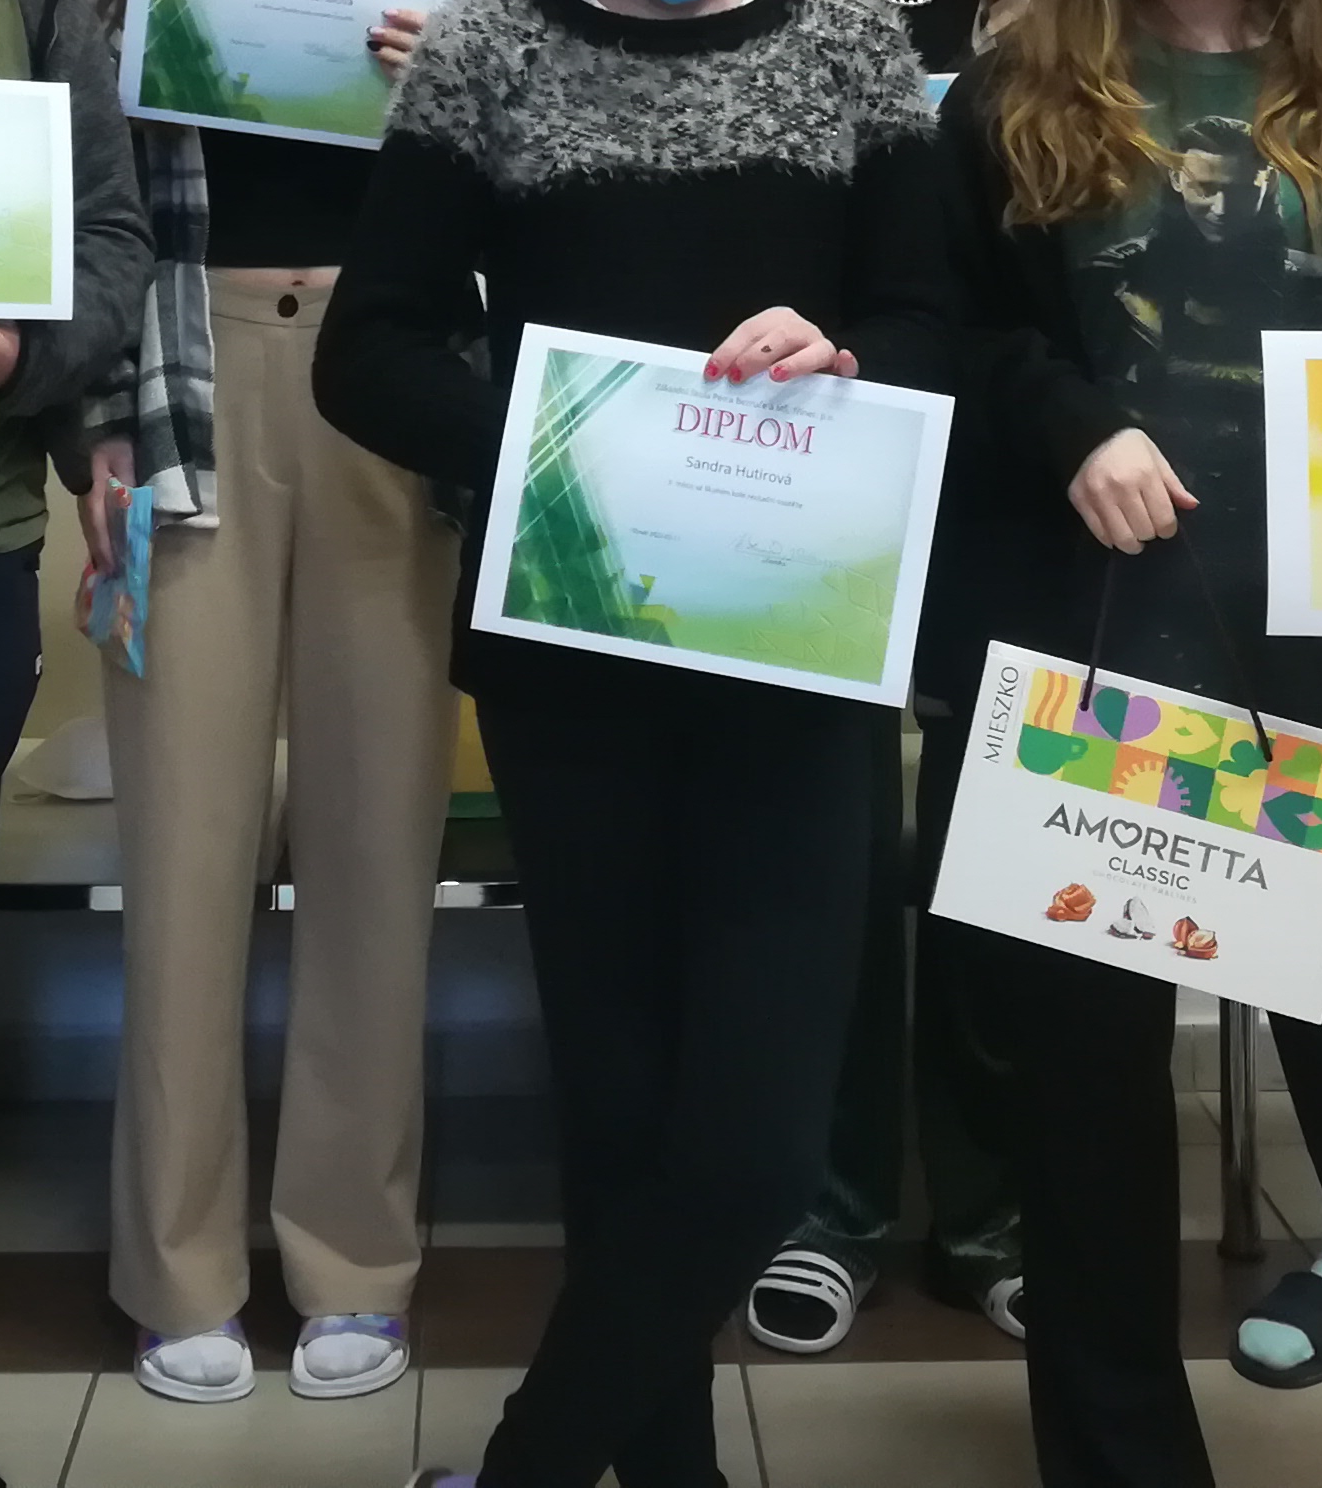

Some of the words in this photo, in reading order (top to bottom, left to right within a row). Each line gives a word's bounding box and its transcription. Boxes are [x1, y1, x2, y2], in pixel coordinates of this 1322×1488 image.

[675, 402, 816, 455] DIPLOM
[686, 456, 732, 475] Sandra
[736, 464, 792, 486] Hutirová
[983, 666, 1019, 764] MIESZKO
[1043, 803, 1269, 890] AMORETTA
[1108, 856, 1190, 890] CLASSIC
